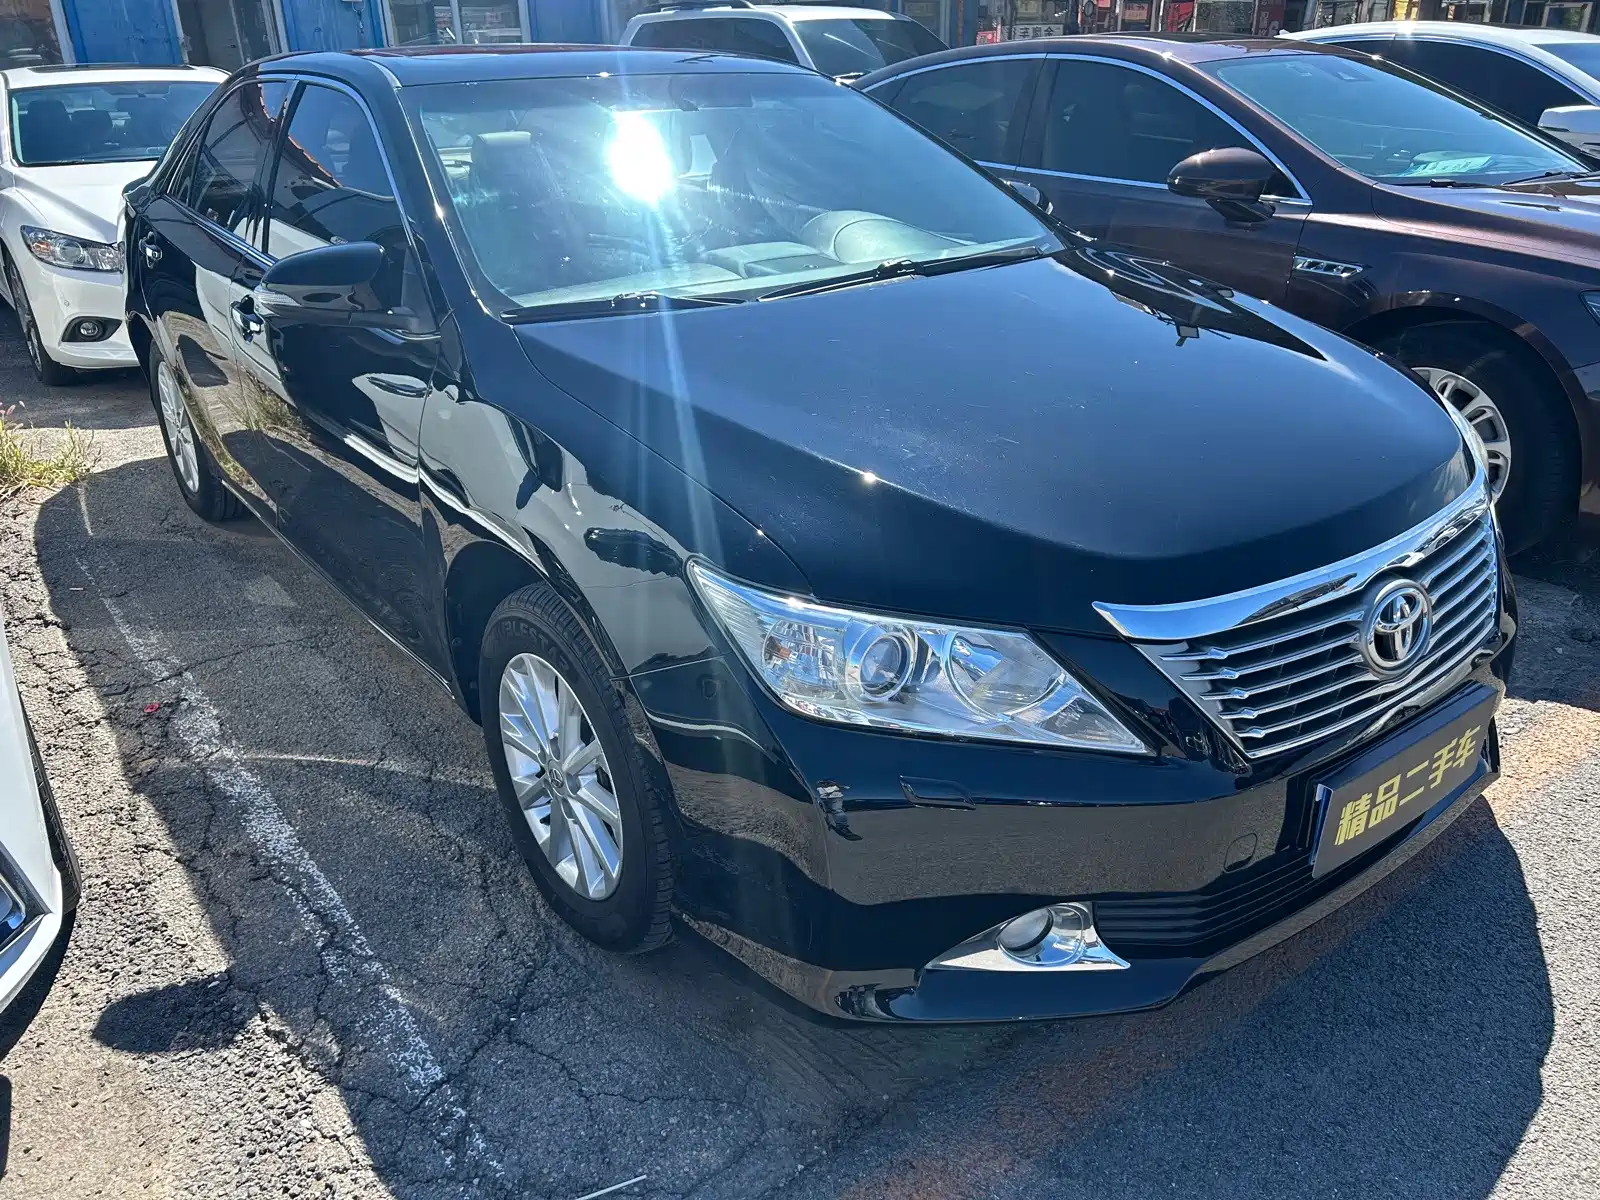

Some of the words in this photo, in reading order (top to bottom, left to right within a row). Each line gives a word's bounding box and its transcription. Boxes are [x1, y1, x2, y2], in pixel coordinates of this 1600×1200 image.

[1334, 725, 1481, 846] 精品二手车
